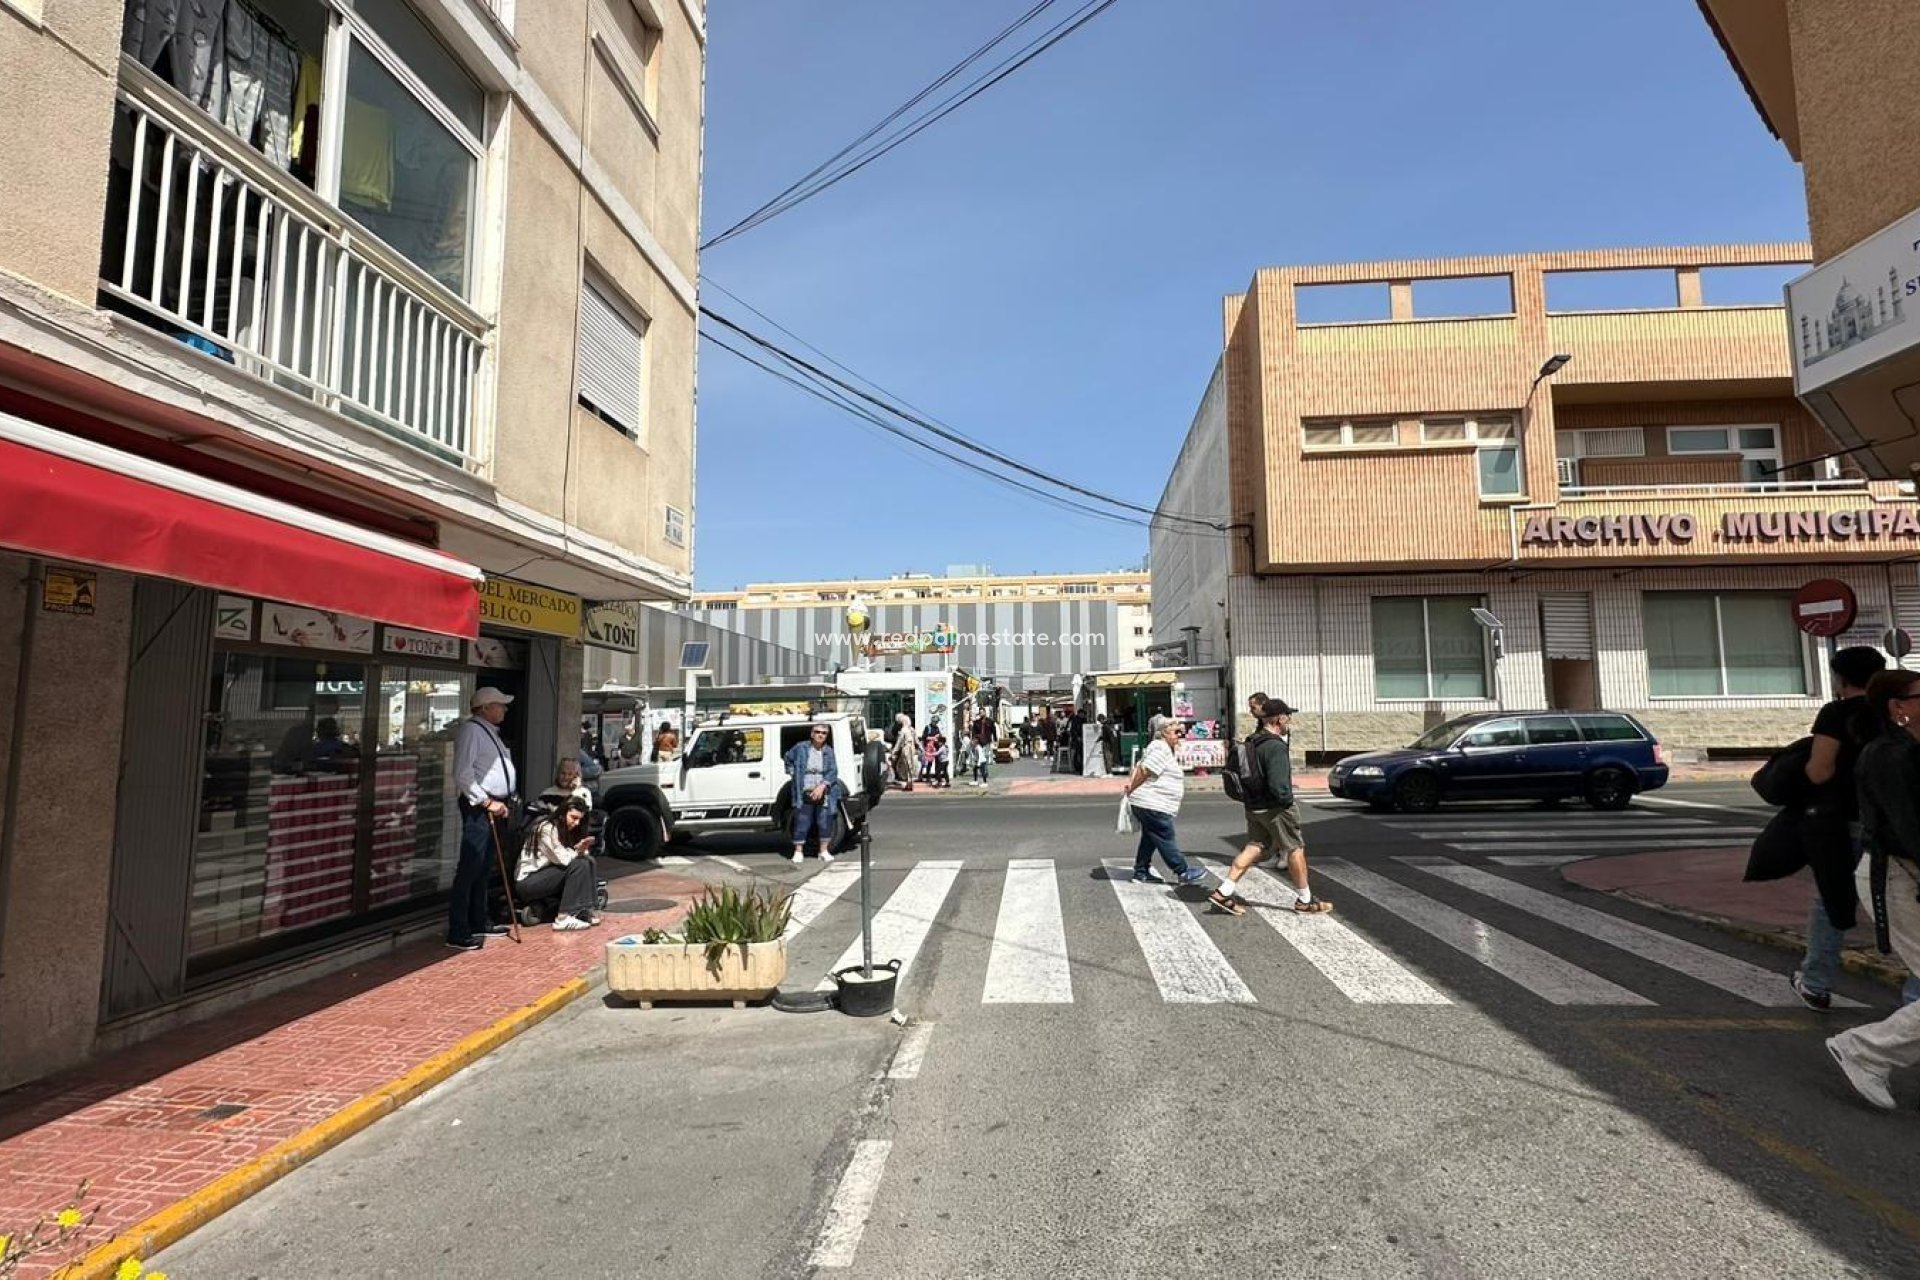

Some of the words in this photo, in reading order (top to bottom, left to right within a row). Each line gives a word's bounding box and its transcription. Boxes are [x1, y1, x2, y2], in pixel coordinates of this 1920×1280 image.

[1524, 512, 1697, 545] ARCHIVO
[1723, 508, 1920, 541] MUNICIPA
[508, 585, 576, 615] MERCADO
[603, 621, 636, 647] TOÑI
